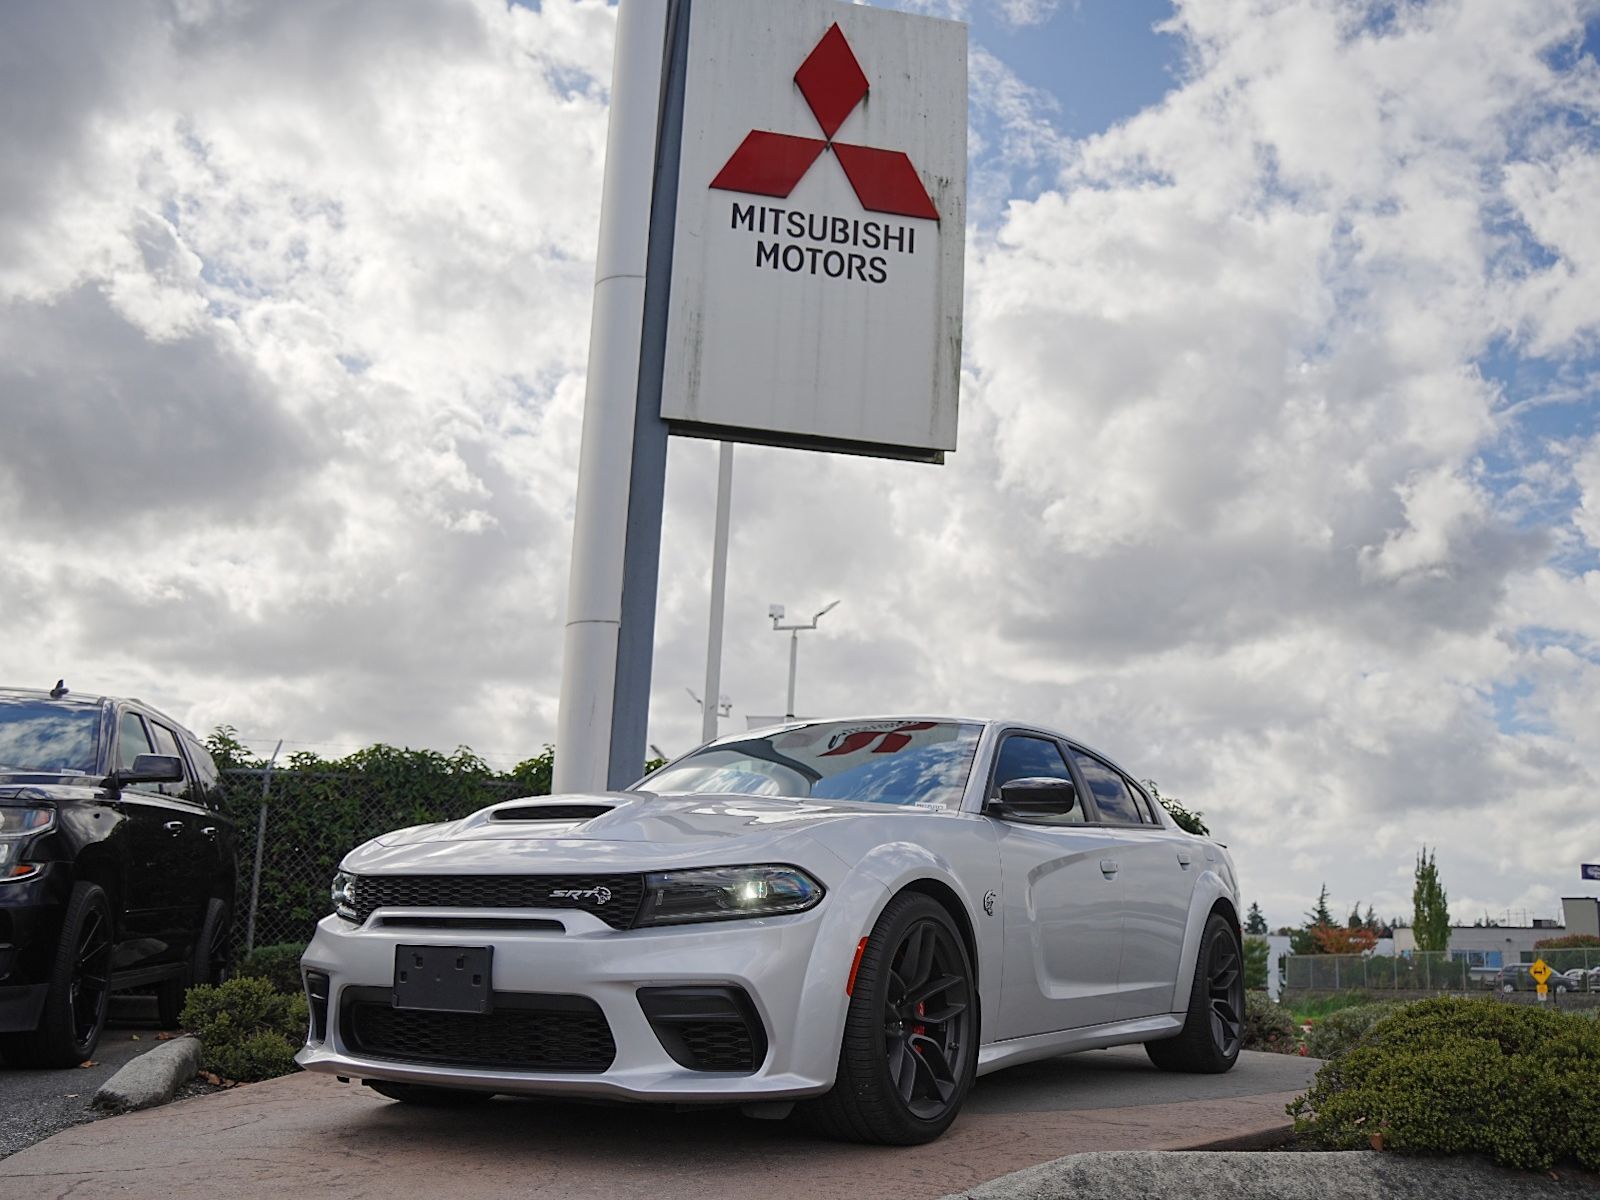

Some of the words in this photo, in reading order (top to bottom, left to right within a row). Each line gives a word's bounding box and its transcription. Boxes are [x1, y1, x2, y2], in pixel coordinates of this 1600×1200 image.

[731, 202, 915, 254] MITSUBISHI
[756, 241, 888, 284] MOTORS
[549, 889, 598, 900] SRT
